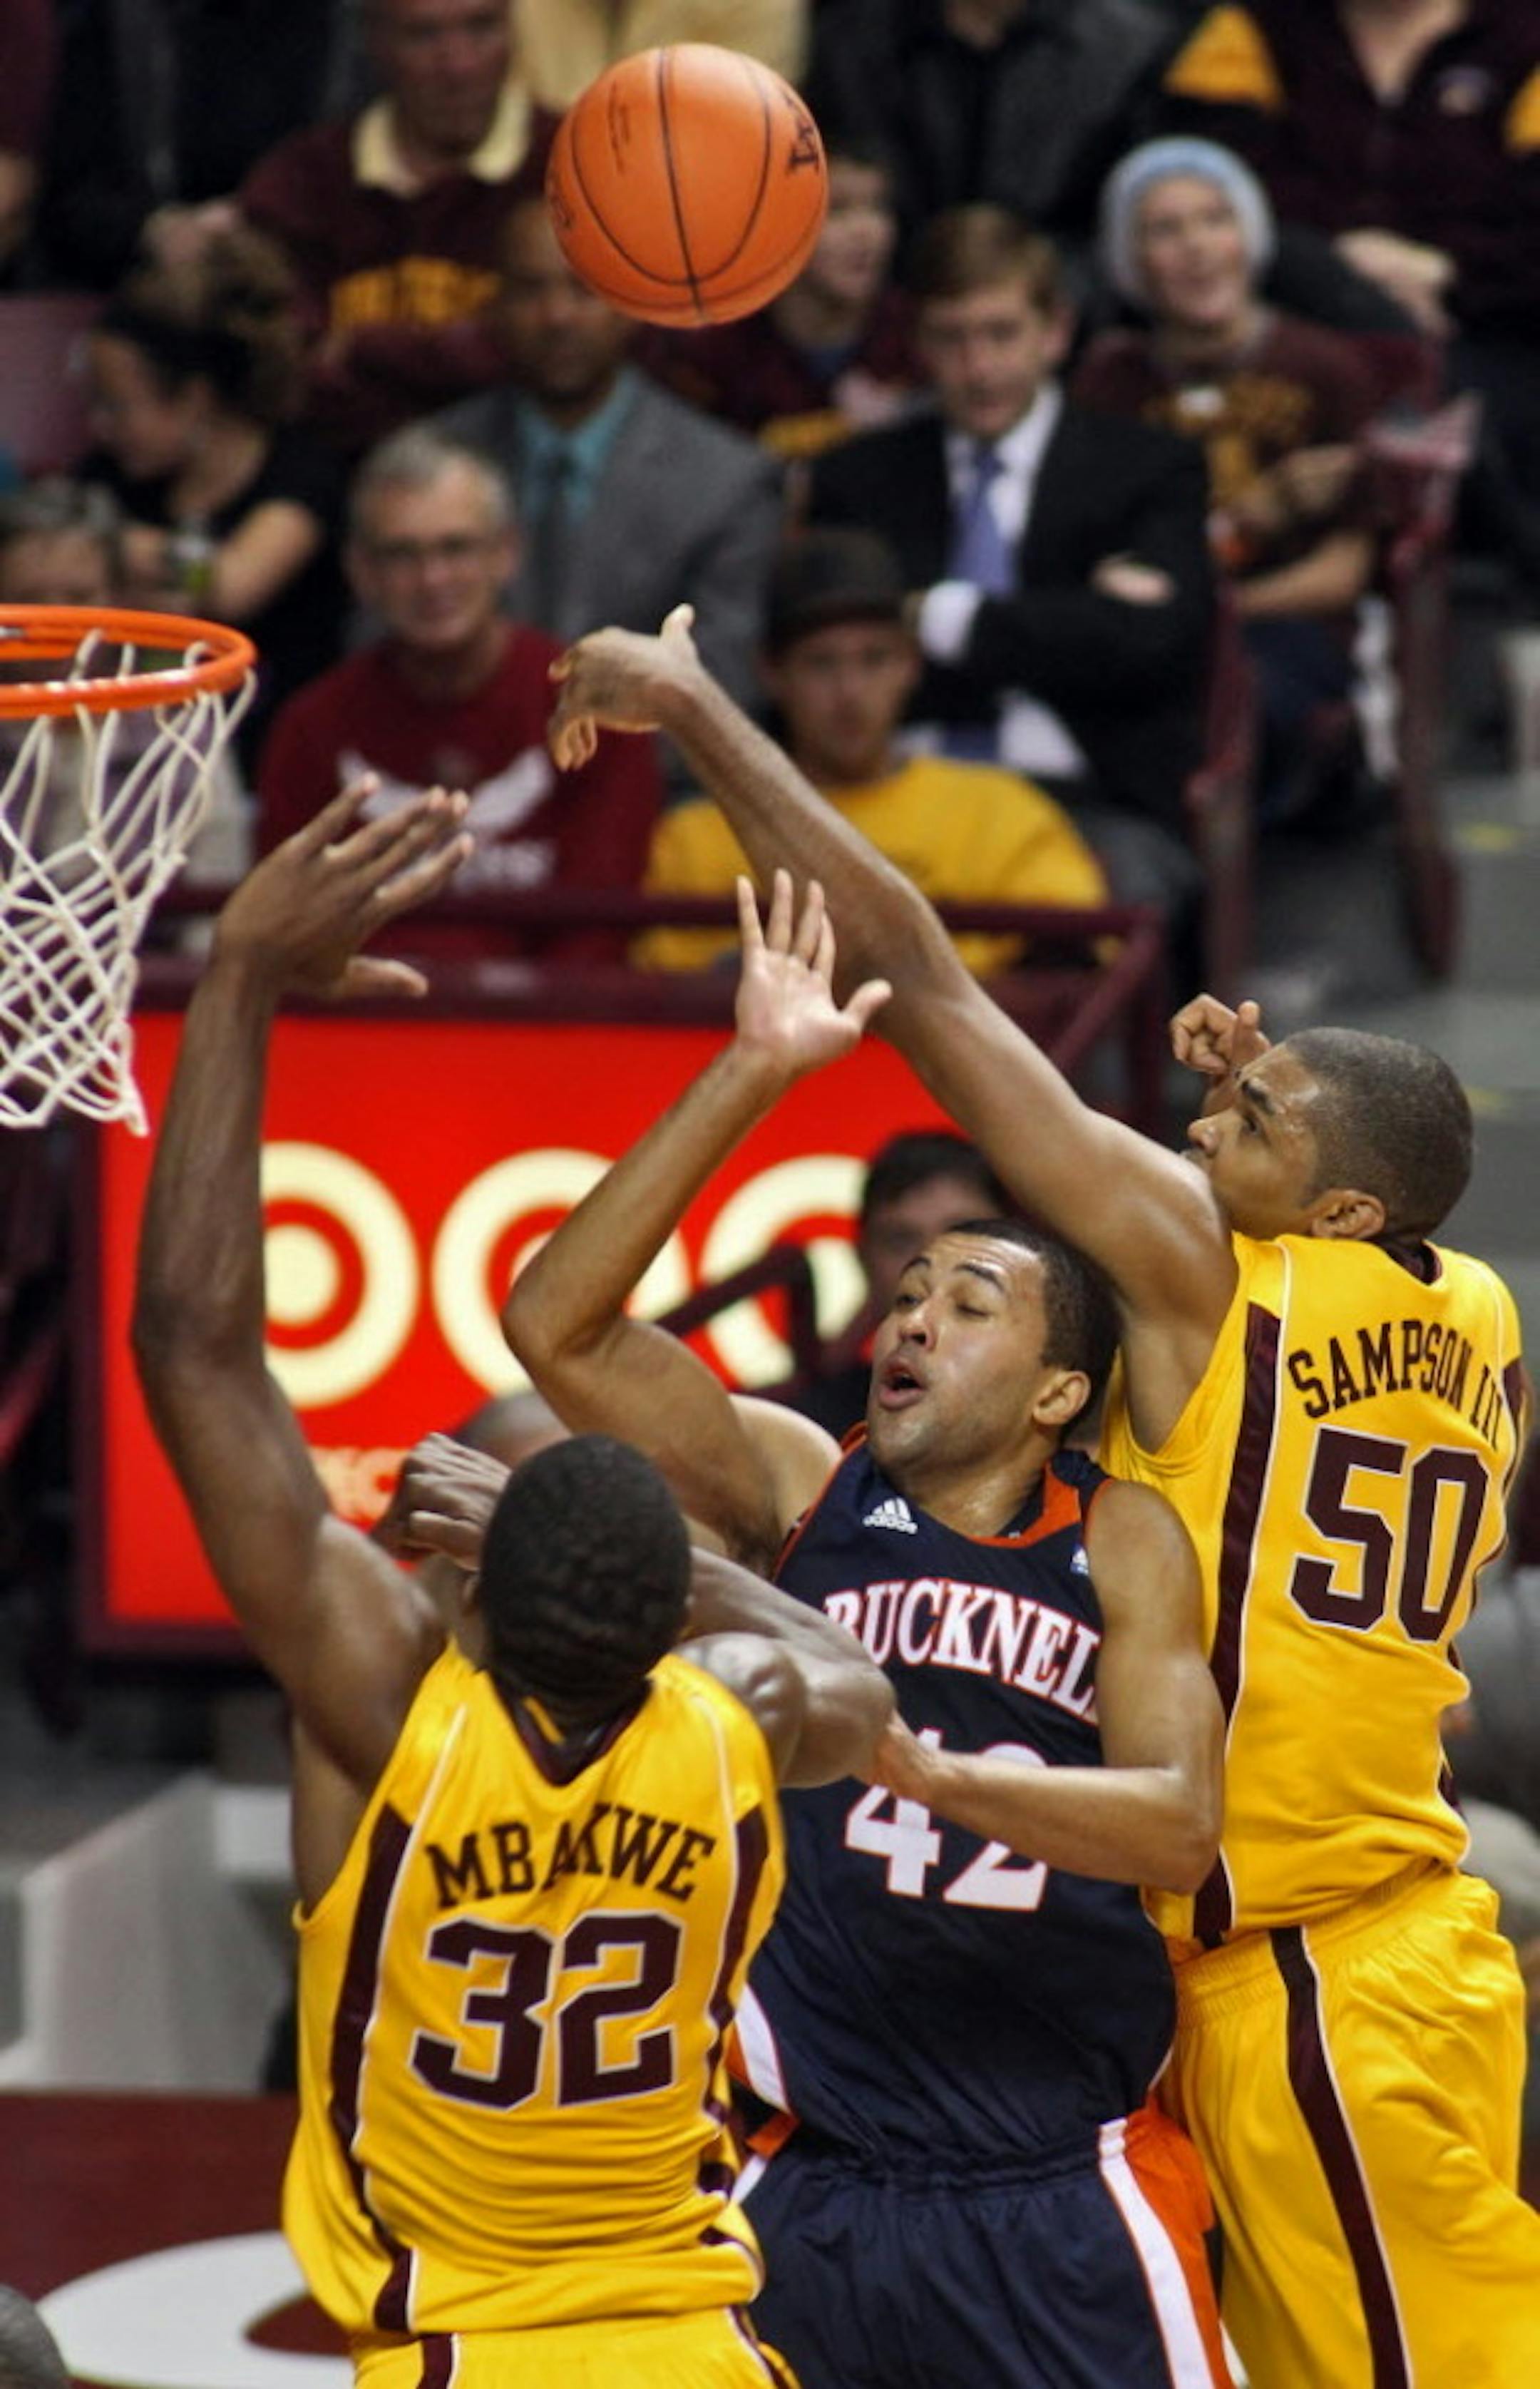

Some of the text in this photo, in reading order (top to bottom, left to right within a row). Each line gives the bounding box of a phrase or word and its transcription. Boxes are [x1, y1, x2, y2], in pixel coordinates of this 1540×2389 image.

[1288, 1319, 1472, 1418] SAMPSON
[861, 1514, 919, 1536] adidas
[1288, 1423, 1491, 1645] 50
[824, 1577, 1101, 1729] BUCKNEL
[423, 1802, 717, 1910] MBAKWE
[844, 1726, 1049, 1912] 42
[409, 1908, 687, 2113] 32
